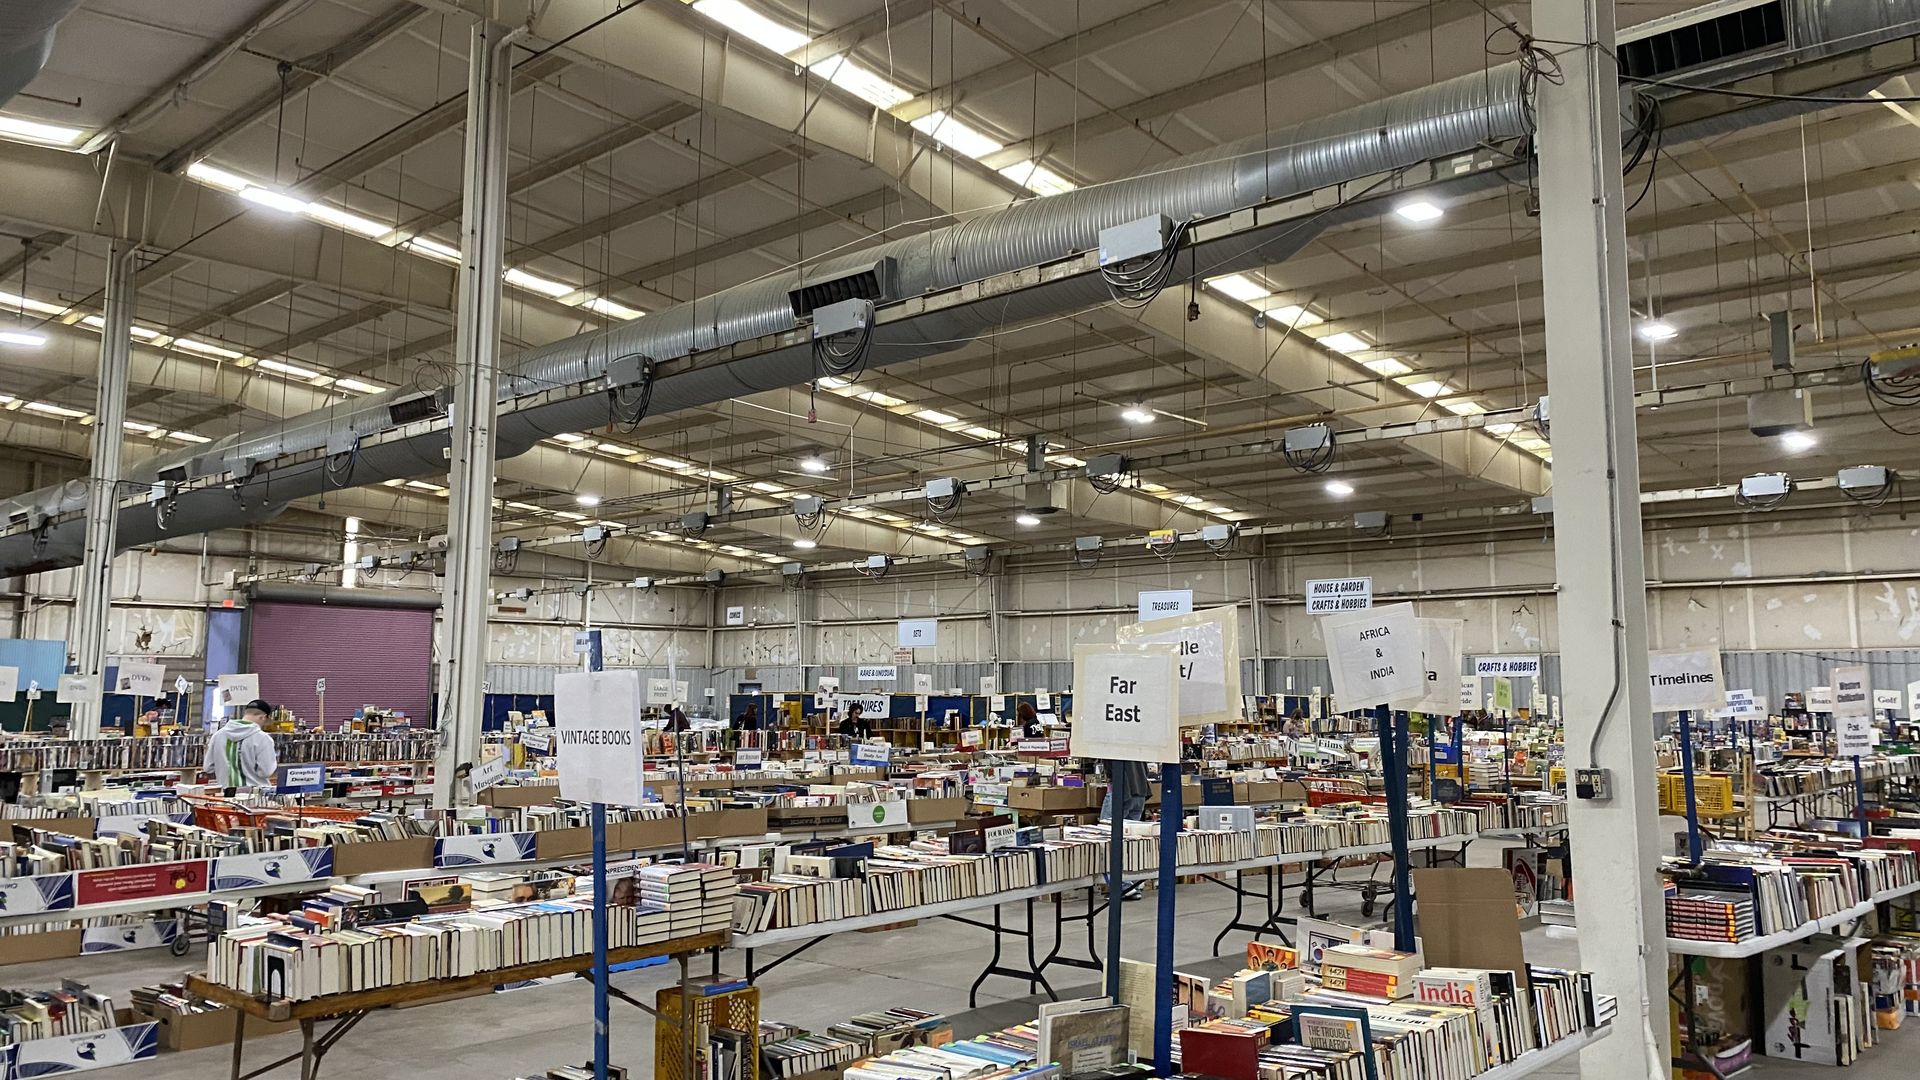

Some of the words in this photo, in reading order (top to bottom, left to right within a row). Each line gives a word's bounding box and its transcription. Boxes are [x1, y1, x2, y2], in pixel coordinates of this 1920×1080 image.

[1314, 583, 1333, 593] HOUSE
[1334, 583, 1340, 592] &
[1341, 581, 1364, 592] GARDEN
[1151, 602, 1179, 611] TREASURES
[1312, 600, 1333, 610] CRAFTS
[1334, 600, 1340, 609] &
[1341, 598, 1367, 609] HOBBIES
[1360, 626, 1390, 641] AFRICA
[1375, 648, 1383, 657] &
[1370, 666, 1394, 679] INDIA
[1478, 662, 1500, 672] CRAFTS
[1502, 662, 1507, 671] &
[1509, 662, 1537, 671] HOBBIES
[1110, 677, 1137, 694] Far
[1650, 673, 1713, 686] Timelines
[1106, 704, 1140, 723] East
[561, 730, 600, 745] VINTAGE
[602, 730, 631, 745] BOOKS
[1319, 740, 1343, 749] Films
[482, 765, 493, 776] Art
[988, 830, 1002, 839] FOUR
[1003, 828, 1015, 836] DAYS
[606, 862, 651, 875] NPRECEDENTD
[1419, 981, 1475, 1004] India
[1308, 1025, 1320, 1037] THE
[1320, 1027, 1351, 1040] TROUBLE
[1309, 1037, 1328, 1049] WITH
[1329, 1038, 1352, 1050] AFRICA
